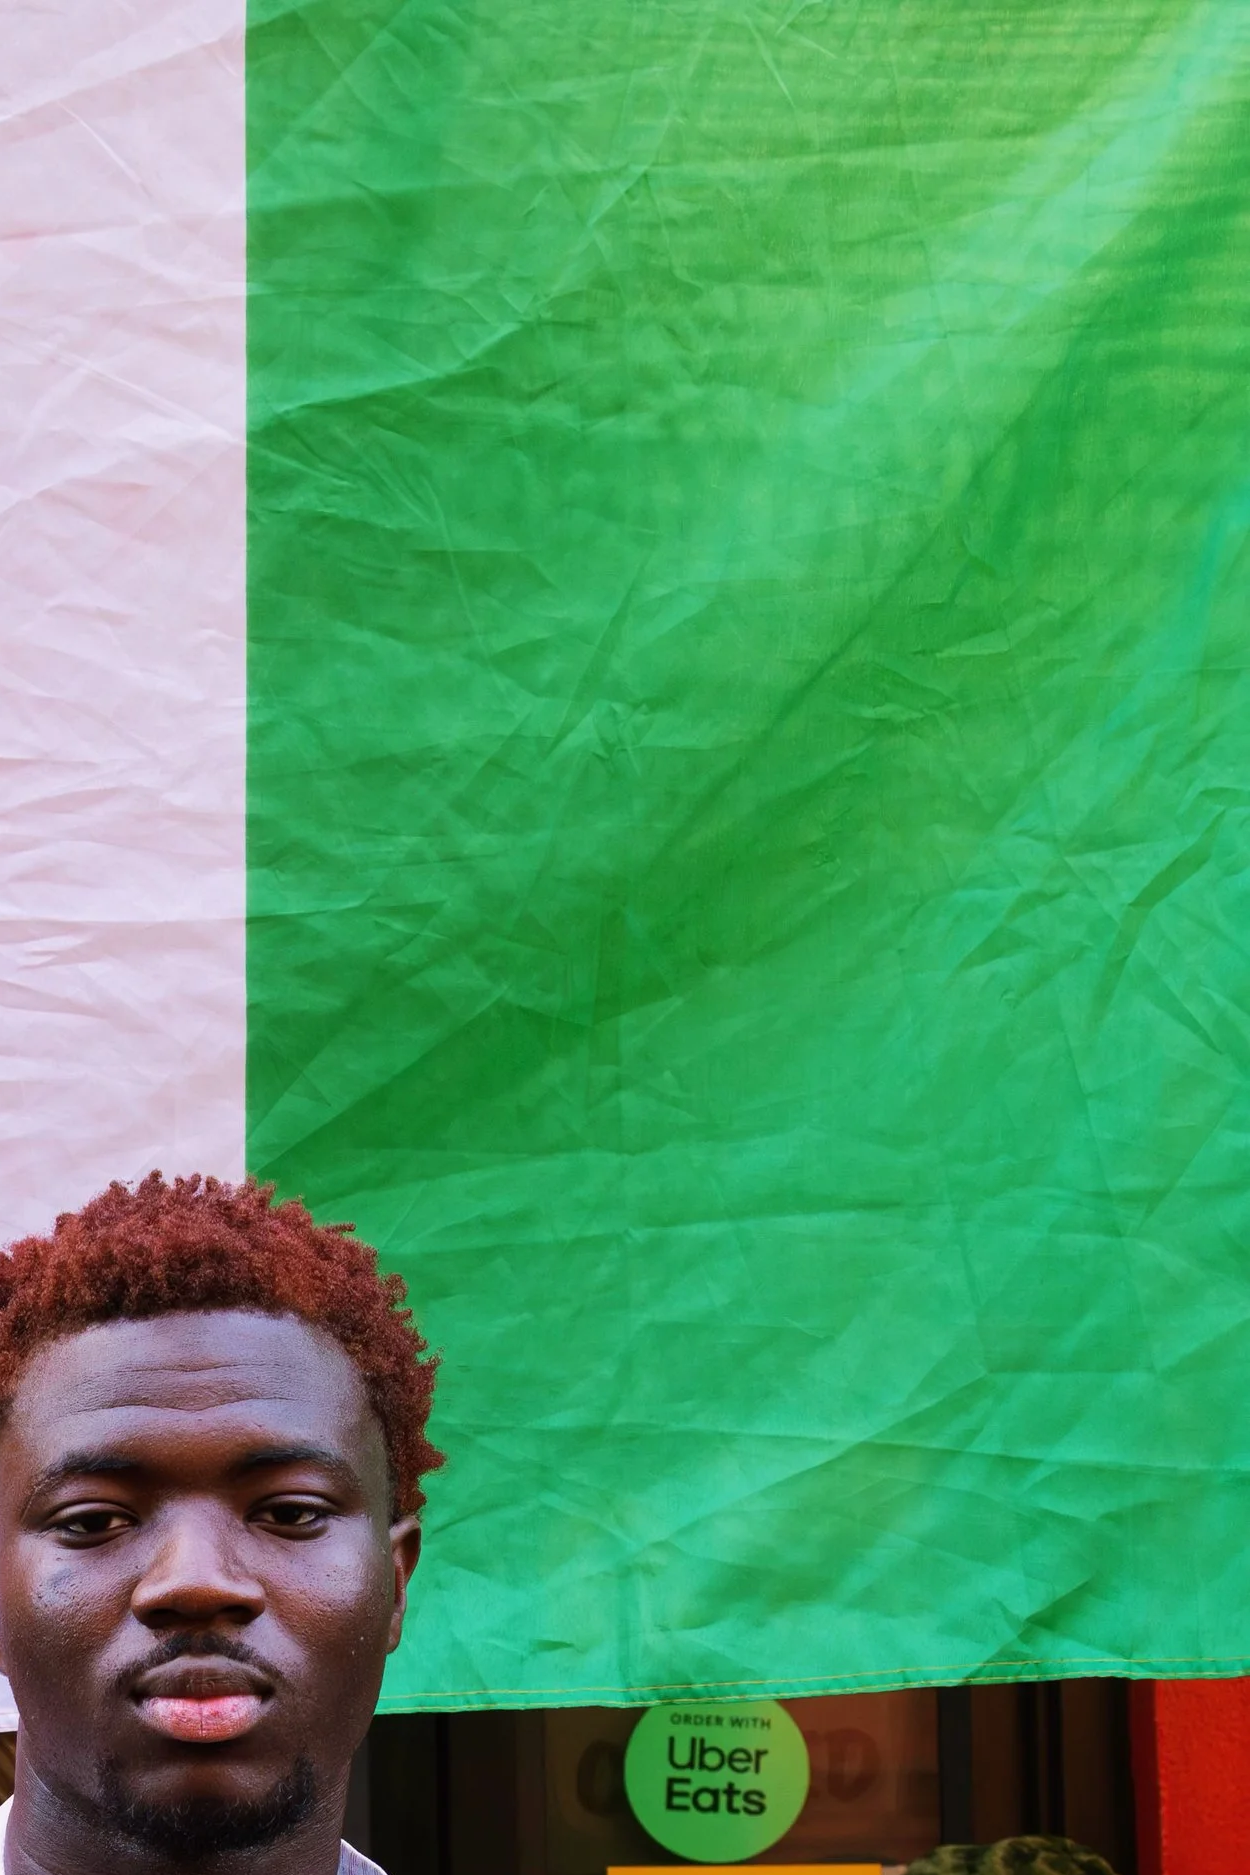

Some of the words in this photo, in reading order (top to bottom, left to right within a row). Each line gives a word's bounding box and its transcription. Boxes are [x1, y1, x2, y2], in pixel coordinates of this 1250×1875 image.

[670, 1713, 724, 1728] ORDER
[729, 1716, 772, 1731] WITH
[667, 1735, 769, 1775] Uber
[665, 1776, 767, 1816] Eats
